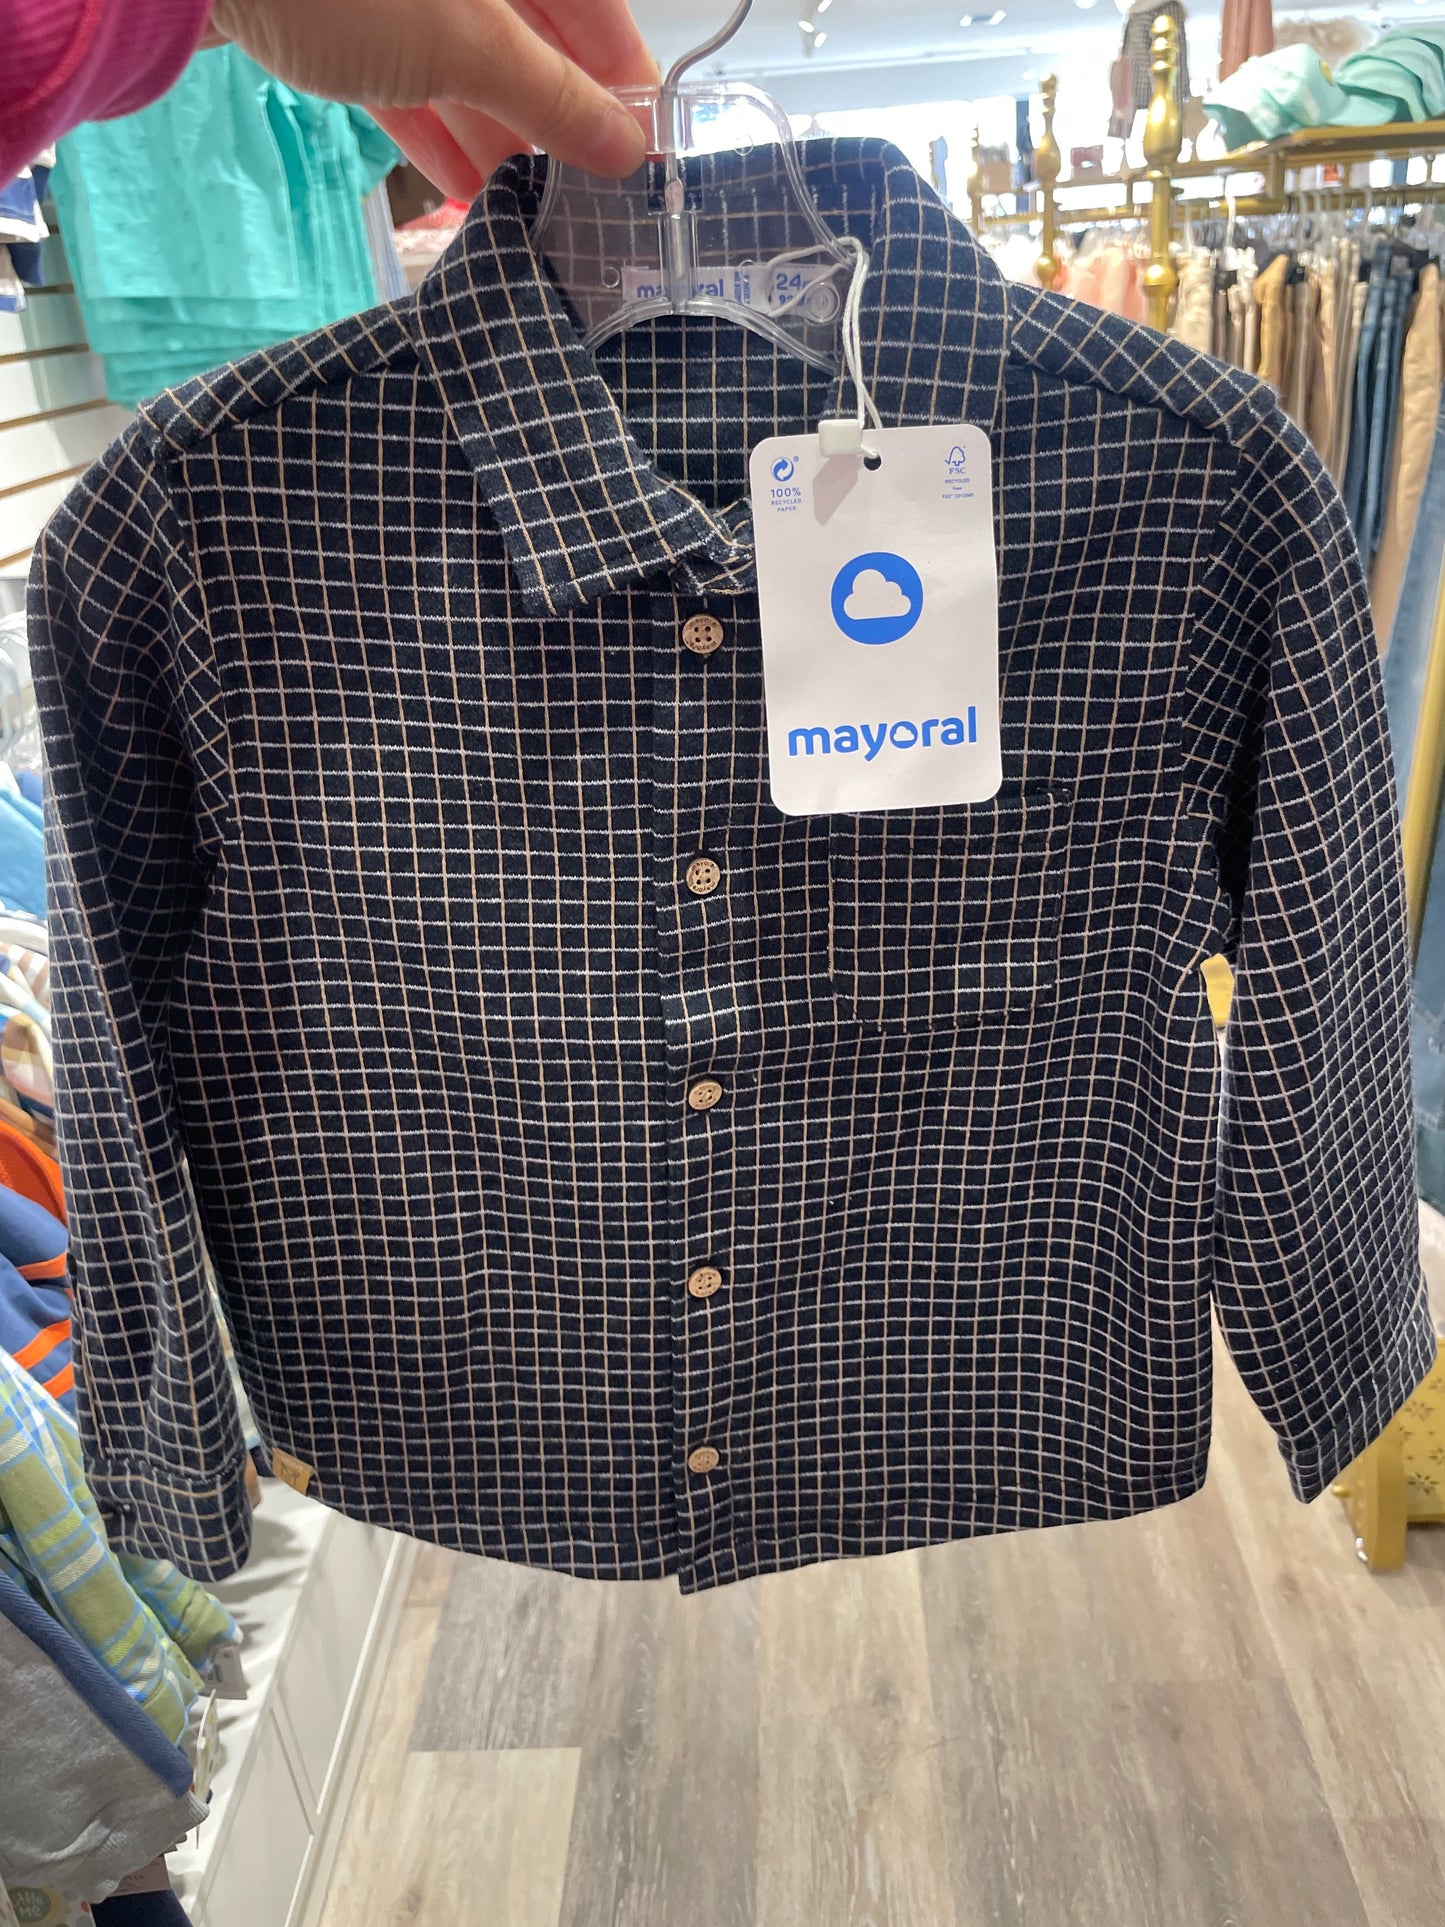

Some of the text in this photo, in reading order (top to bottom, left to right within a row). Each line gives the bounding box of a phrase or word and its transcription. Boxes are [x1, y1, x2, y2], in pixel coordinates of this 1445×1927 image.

[637, 278, 724, 298] maral
[949, 467, 966, 475] FSC
[770, 487, 802, 498] 100%
[771, 498, 802, 506] RECYCLED
[788, 706, 977, 762] mayoral
